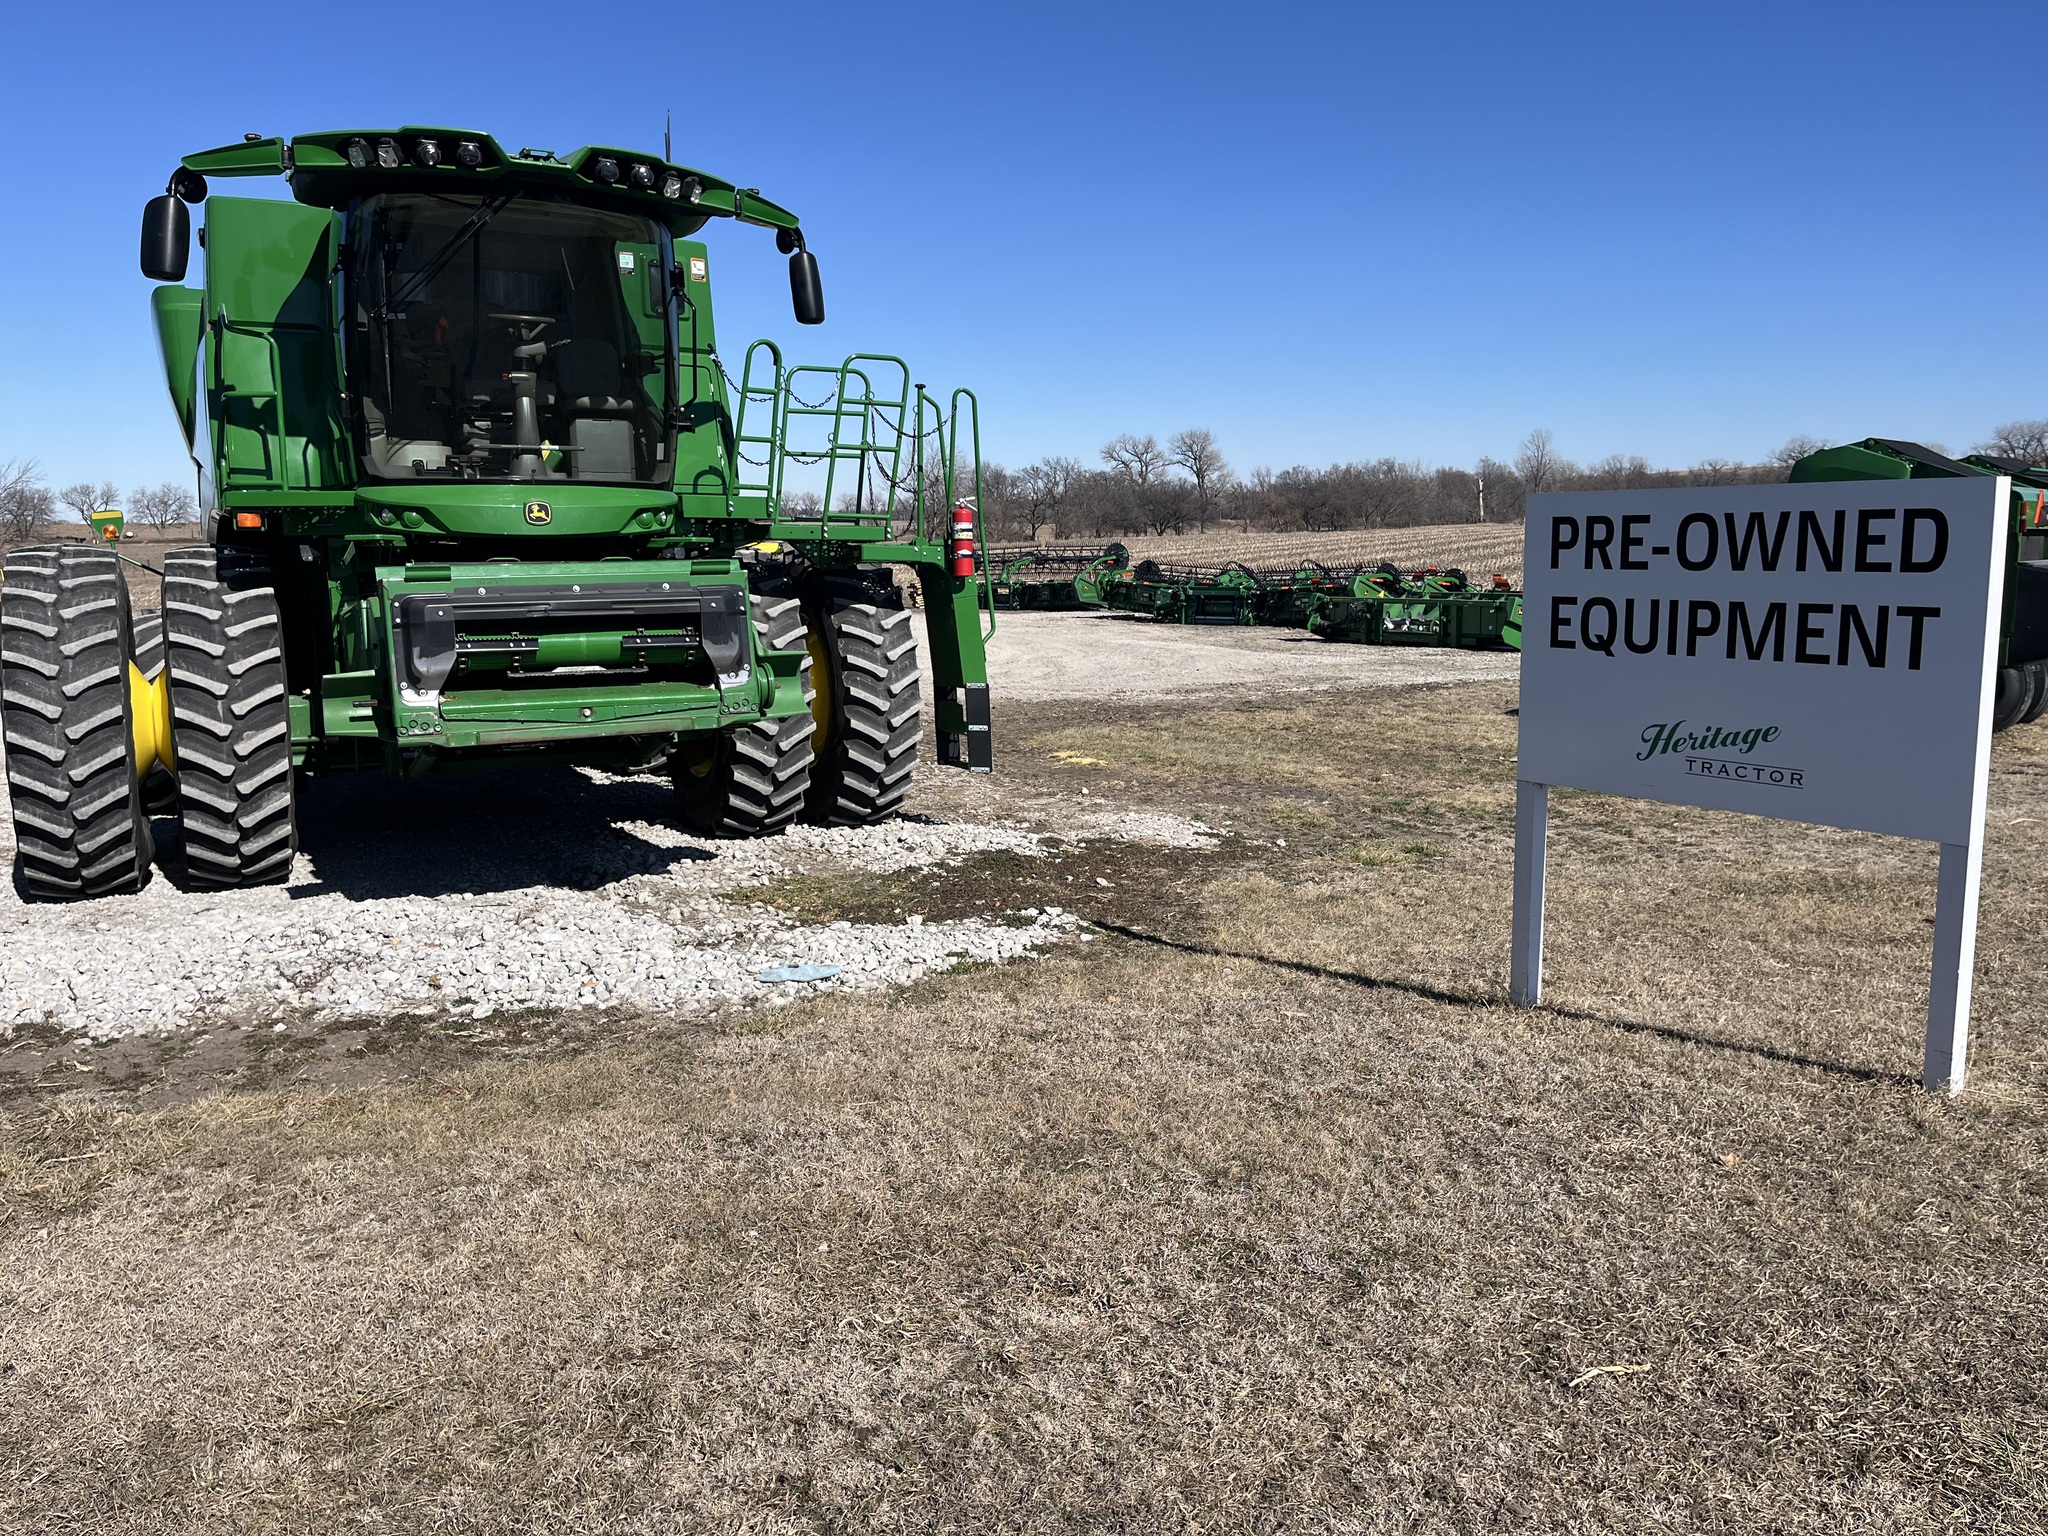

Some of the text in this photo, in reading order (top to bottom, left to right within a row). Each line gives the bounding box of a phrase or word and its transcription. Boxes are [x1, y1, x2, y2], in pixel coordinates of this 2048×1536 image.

[1550, 507, 1950, 574] PRE-OWNED
[1549, 595, 1942, 671] EQUIPMENT
[1636, 719, 1782, 762] Heritage
[1685, 759, 1804, 787] TRACTOR
